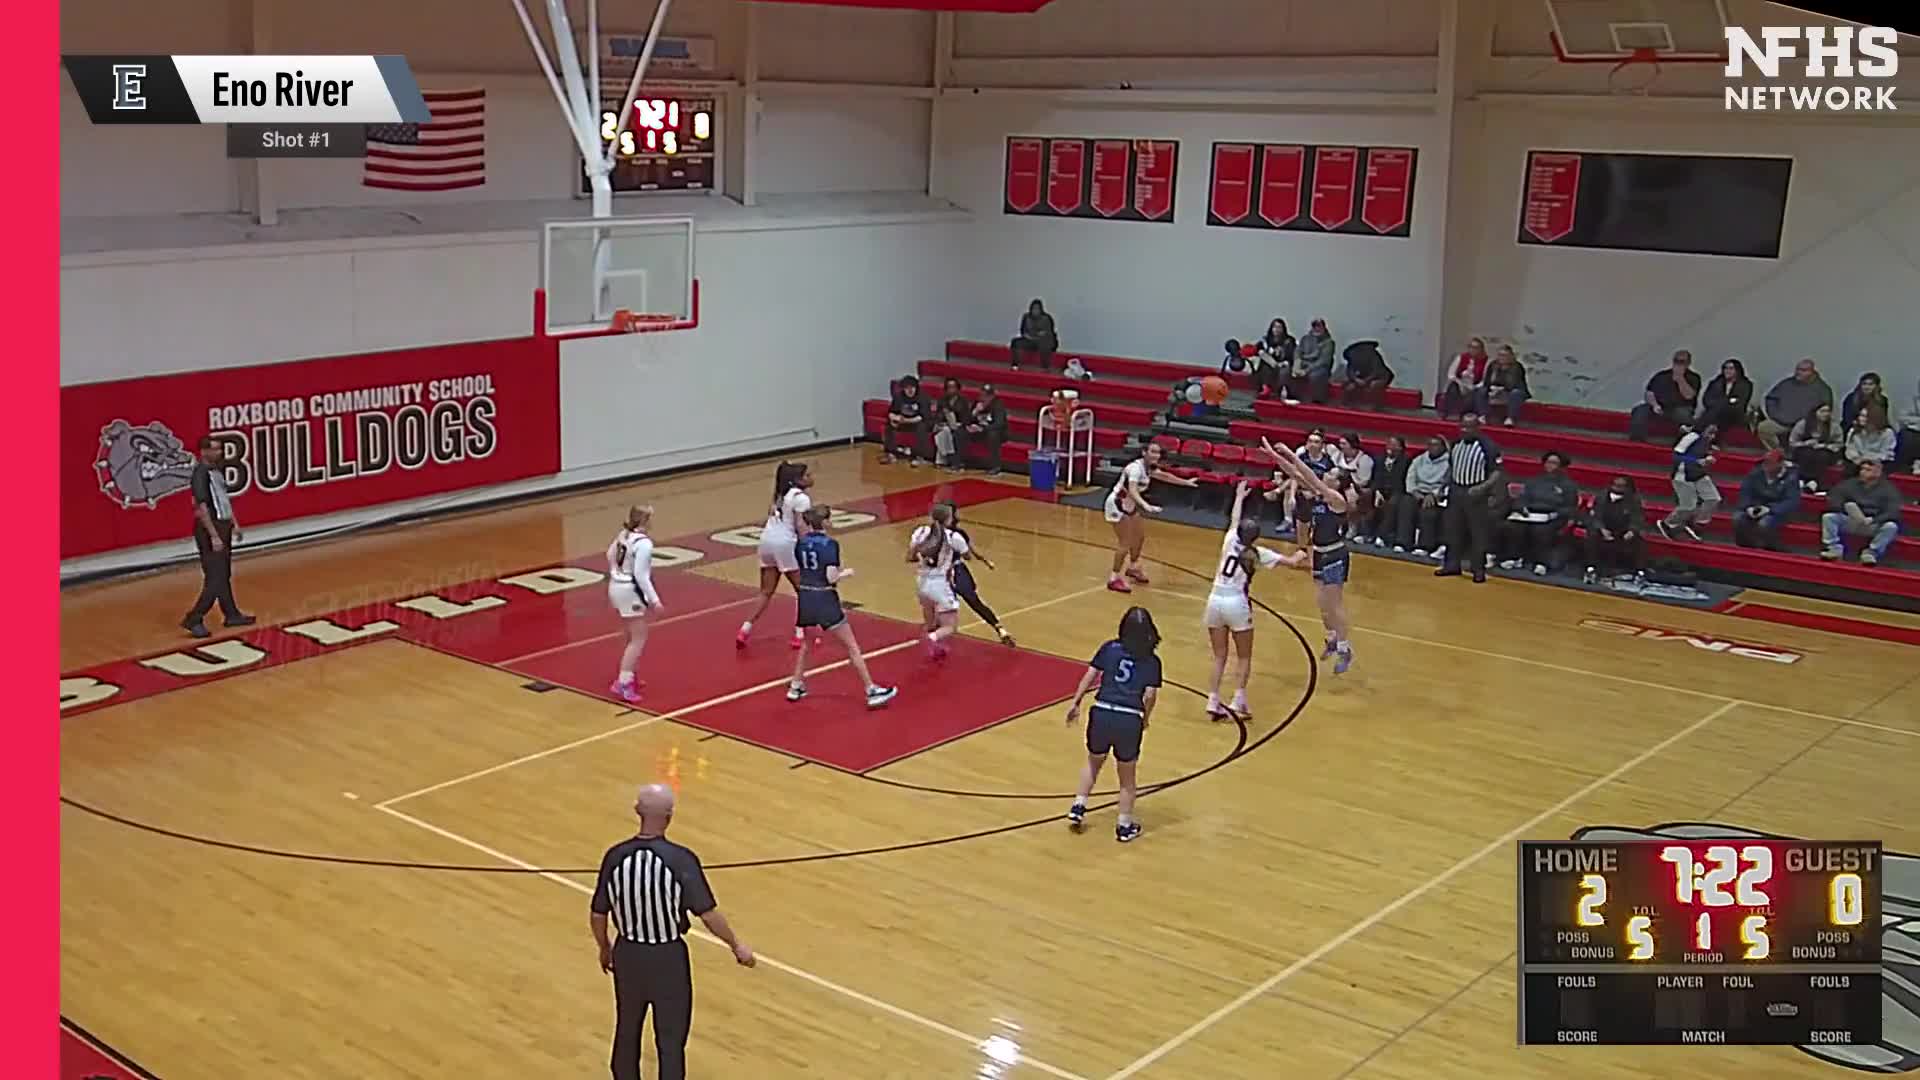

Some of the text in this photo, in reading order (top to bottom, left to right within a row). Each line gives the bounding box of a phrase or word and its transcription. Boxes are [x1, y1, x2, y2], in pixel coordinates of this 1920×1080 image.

[208, 374, 496, 430] ROXBORO COMMUNITY SCHOOL
[208, 395, 497, 498] BULLDOGS
[801, 550, 819, 570] 13
[1222, 553, 1239, 578] 0
[1114, 658, 1135, 683] 5
